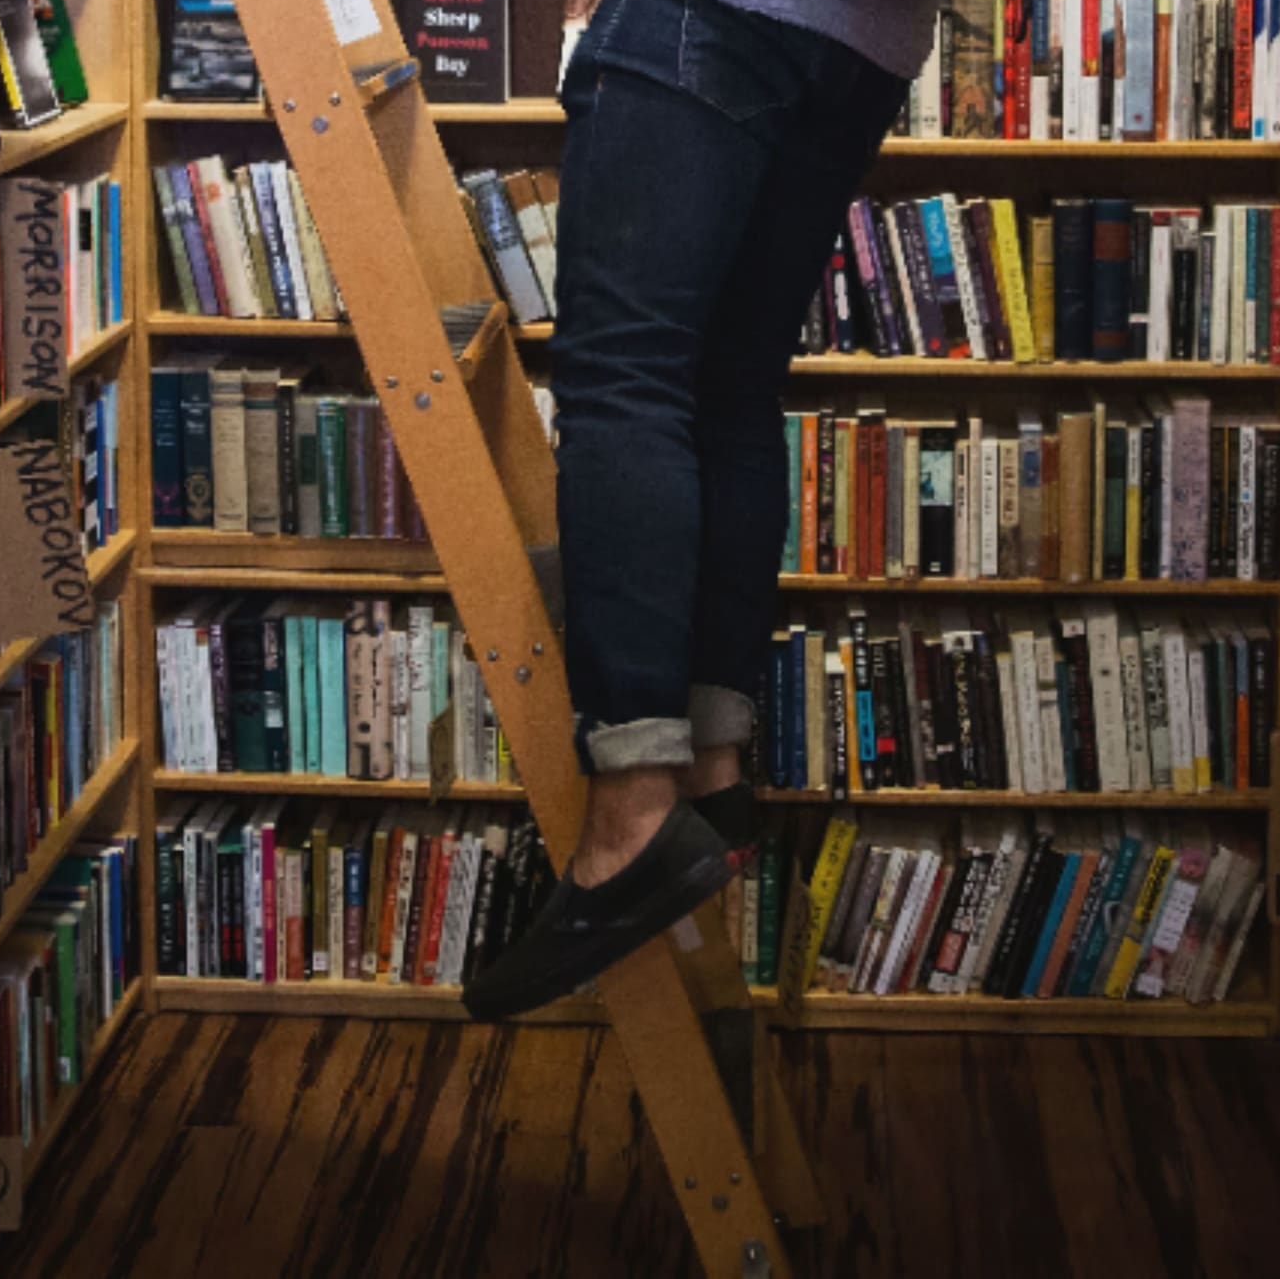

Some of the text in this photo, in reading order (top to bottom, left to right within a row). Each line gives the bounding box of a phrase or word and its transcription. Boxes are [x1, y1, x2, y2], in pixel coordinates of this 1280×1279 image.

[423, 7, 481, 31] Sheep
[435, 55, 469, 77] Boy
[16, 180, 66, 399] MORRISON
[17, 438, 98, 633] NABOKOV
